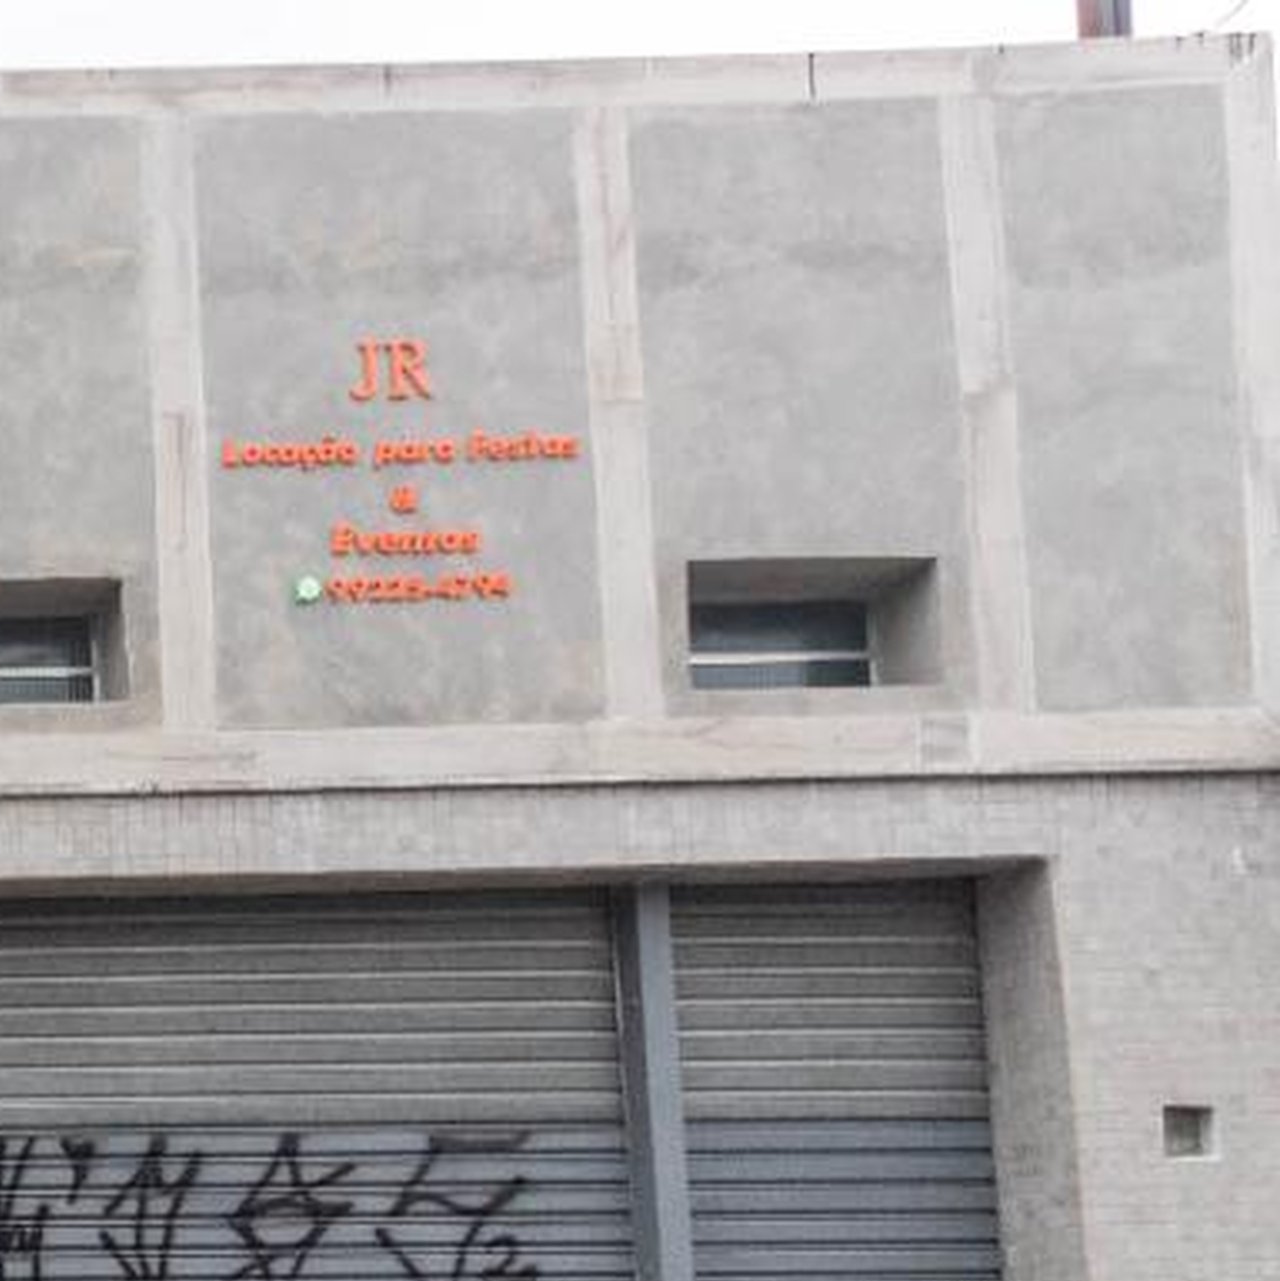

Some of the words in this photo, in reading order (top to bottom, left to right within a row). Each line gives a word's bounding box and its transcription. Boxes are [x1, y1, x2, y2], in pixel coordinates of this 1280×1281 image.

[349, 336, 432, 402] JR
[221, 435, 358, 471] Locação
[372, 440, 456, 471] para
[467, 429, 580, 462] Festas
[331, 524, 482, 556] Eventos
